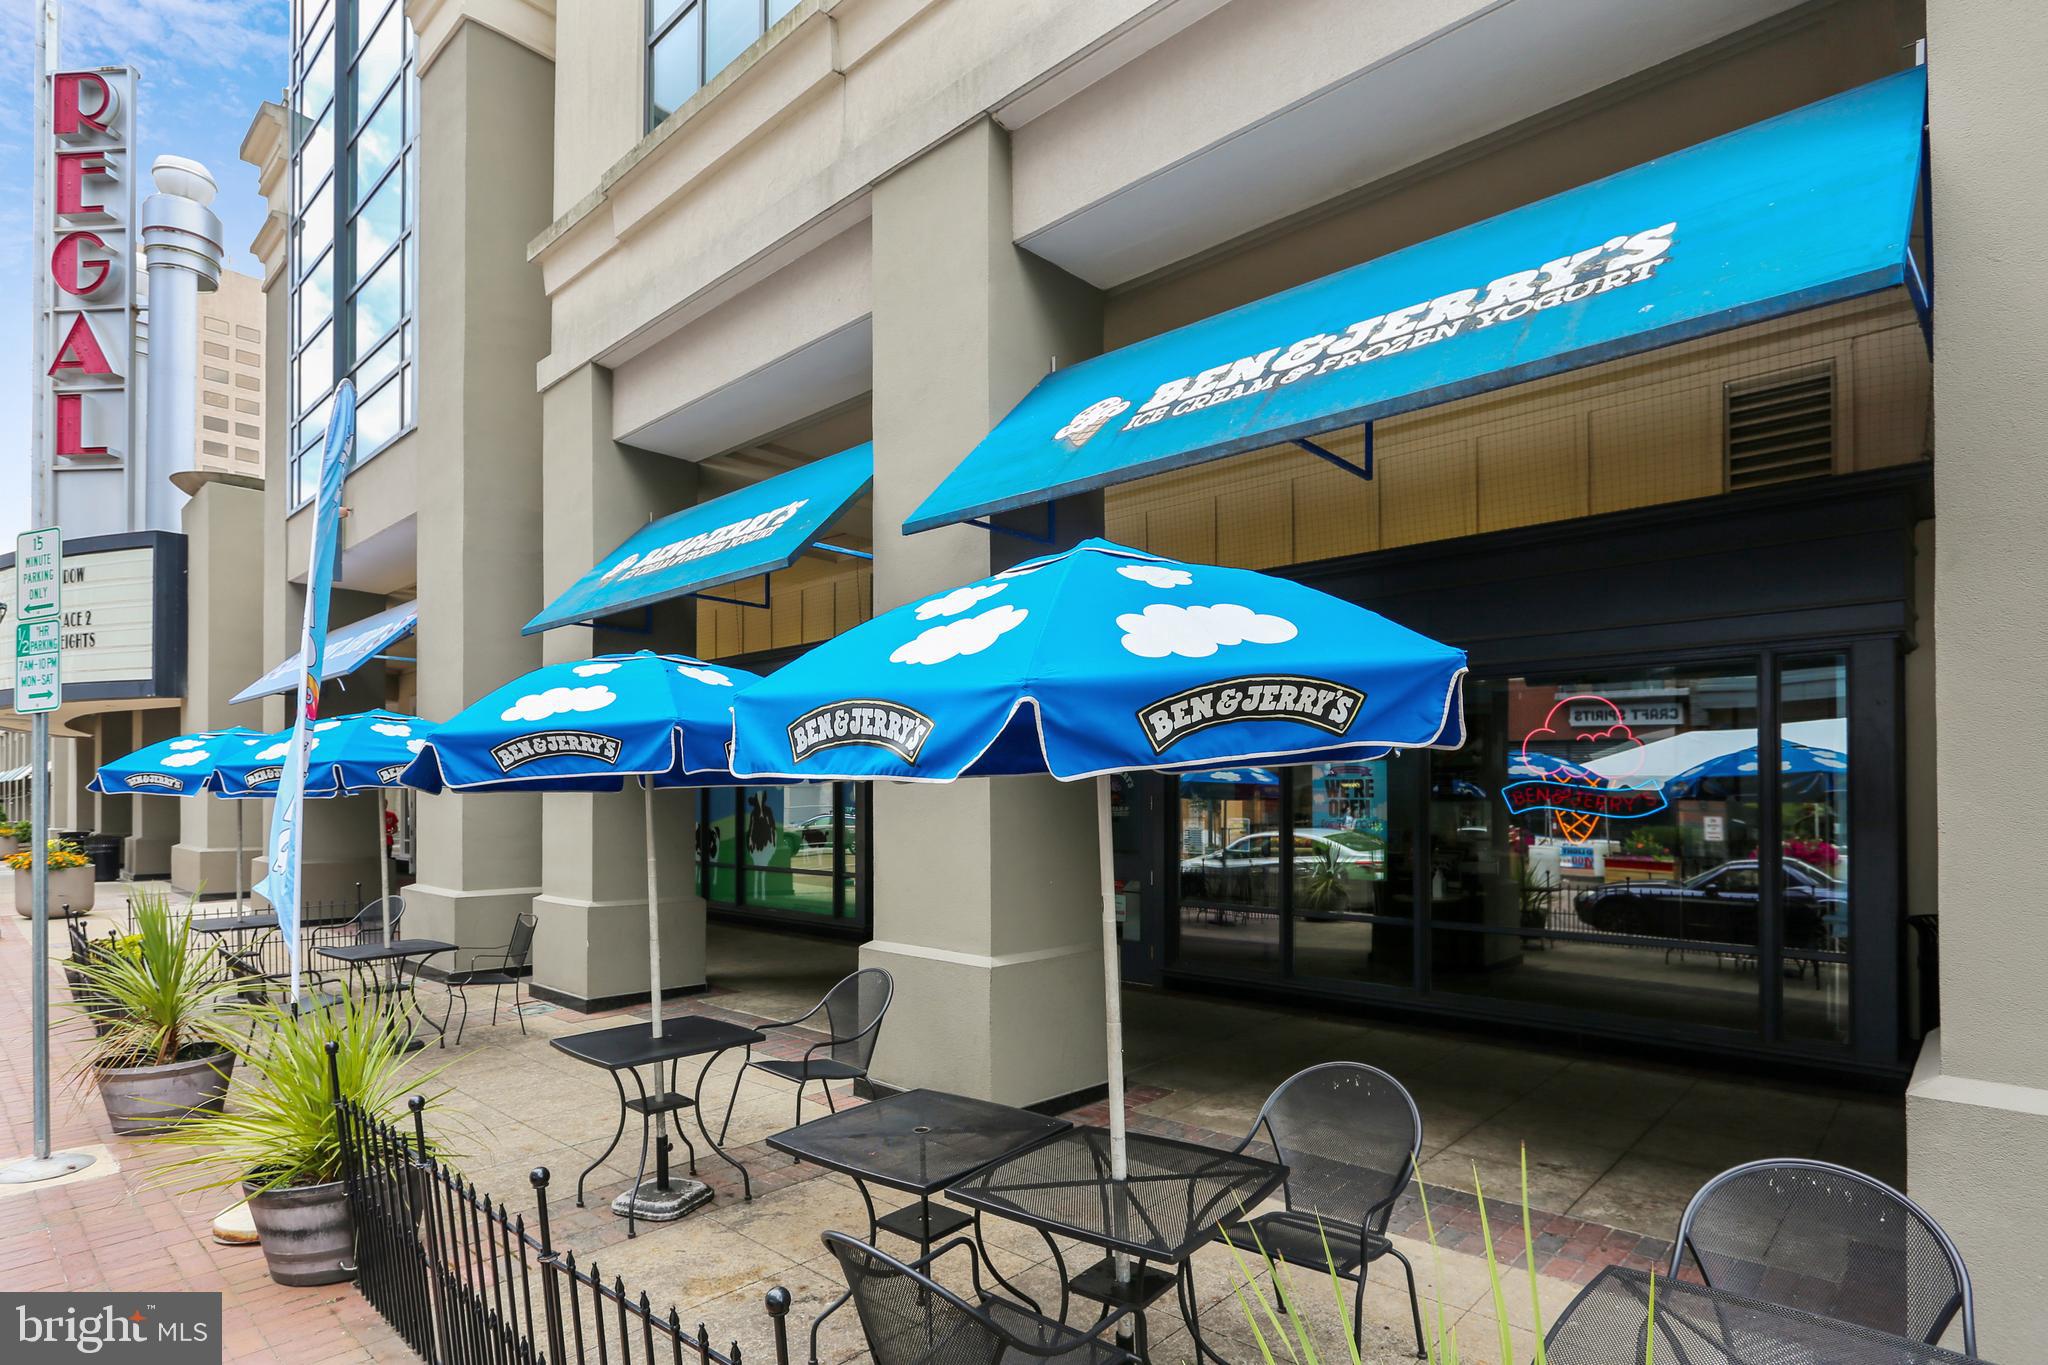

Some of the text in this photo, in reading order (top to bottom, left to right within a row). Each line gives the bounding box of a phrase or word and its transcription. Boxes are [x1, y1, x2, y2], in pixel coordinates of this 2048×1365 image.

[48, 71, 120, 461] REGAL
[1122, 258, 1664, 431] ICE CREAM & FROZEN YOGURT
[33, 536, 44, 551] 15
[25, 553, 52, 568] MINUTE
[23, 569, 54, 584] PARKING
[63, 567, 85, 584] DOW
[29, 587, 48, 600] ONLY
[63, 611, 92, 627] ACE 2
[39, 625, 49, 637] HR
[30, 638, 58, 652] PARKING
[61, 632, 96, 649] EIGHTS
[1328, 799, 1371, 818] OPEN
